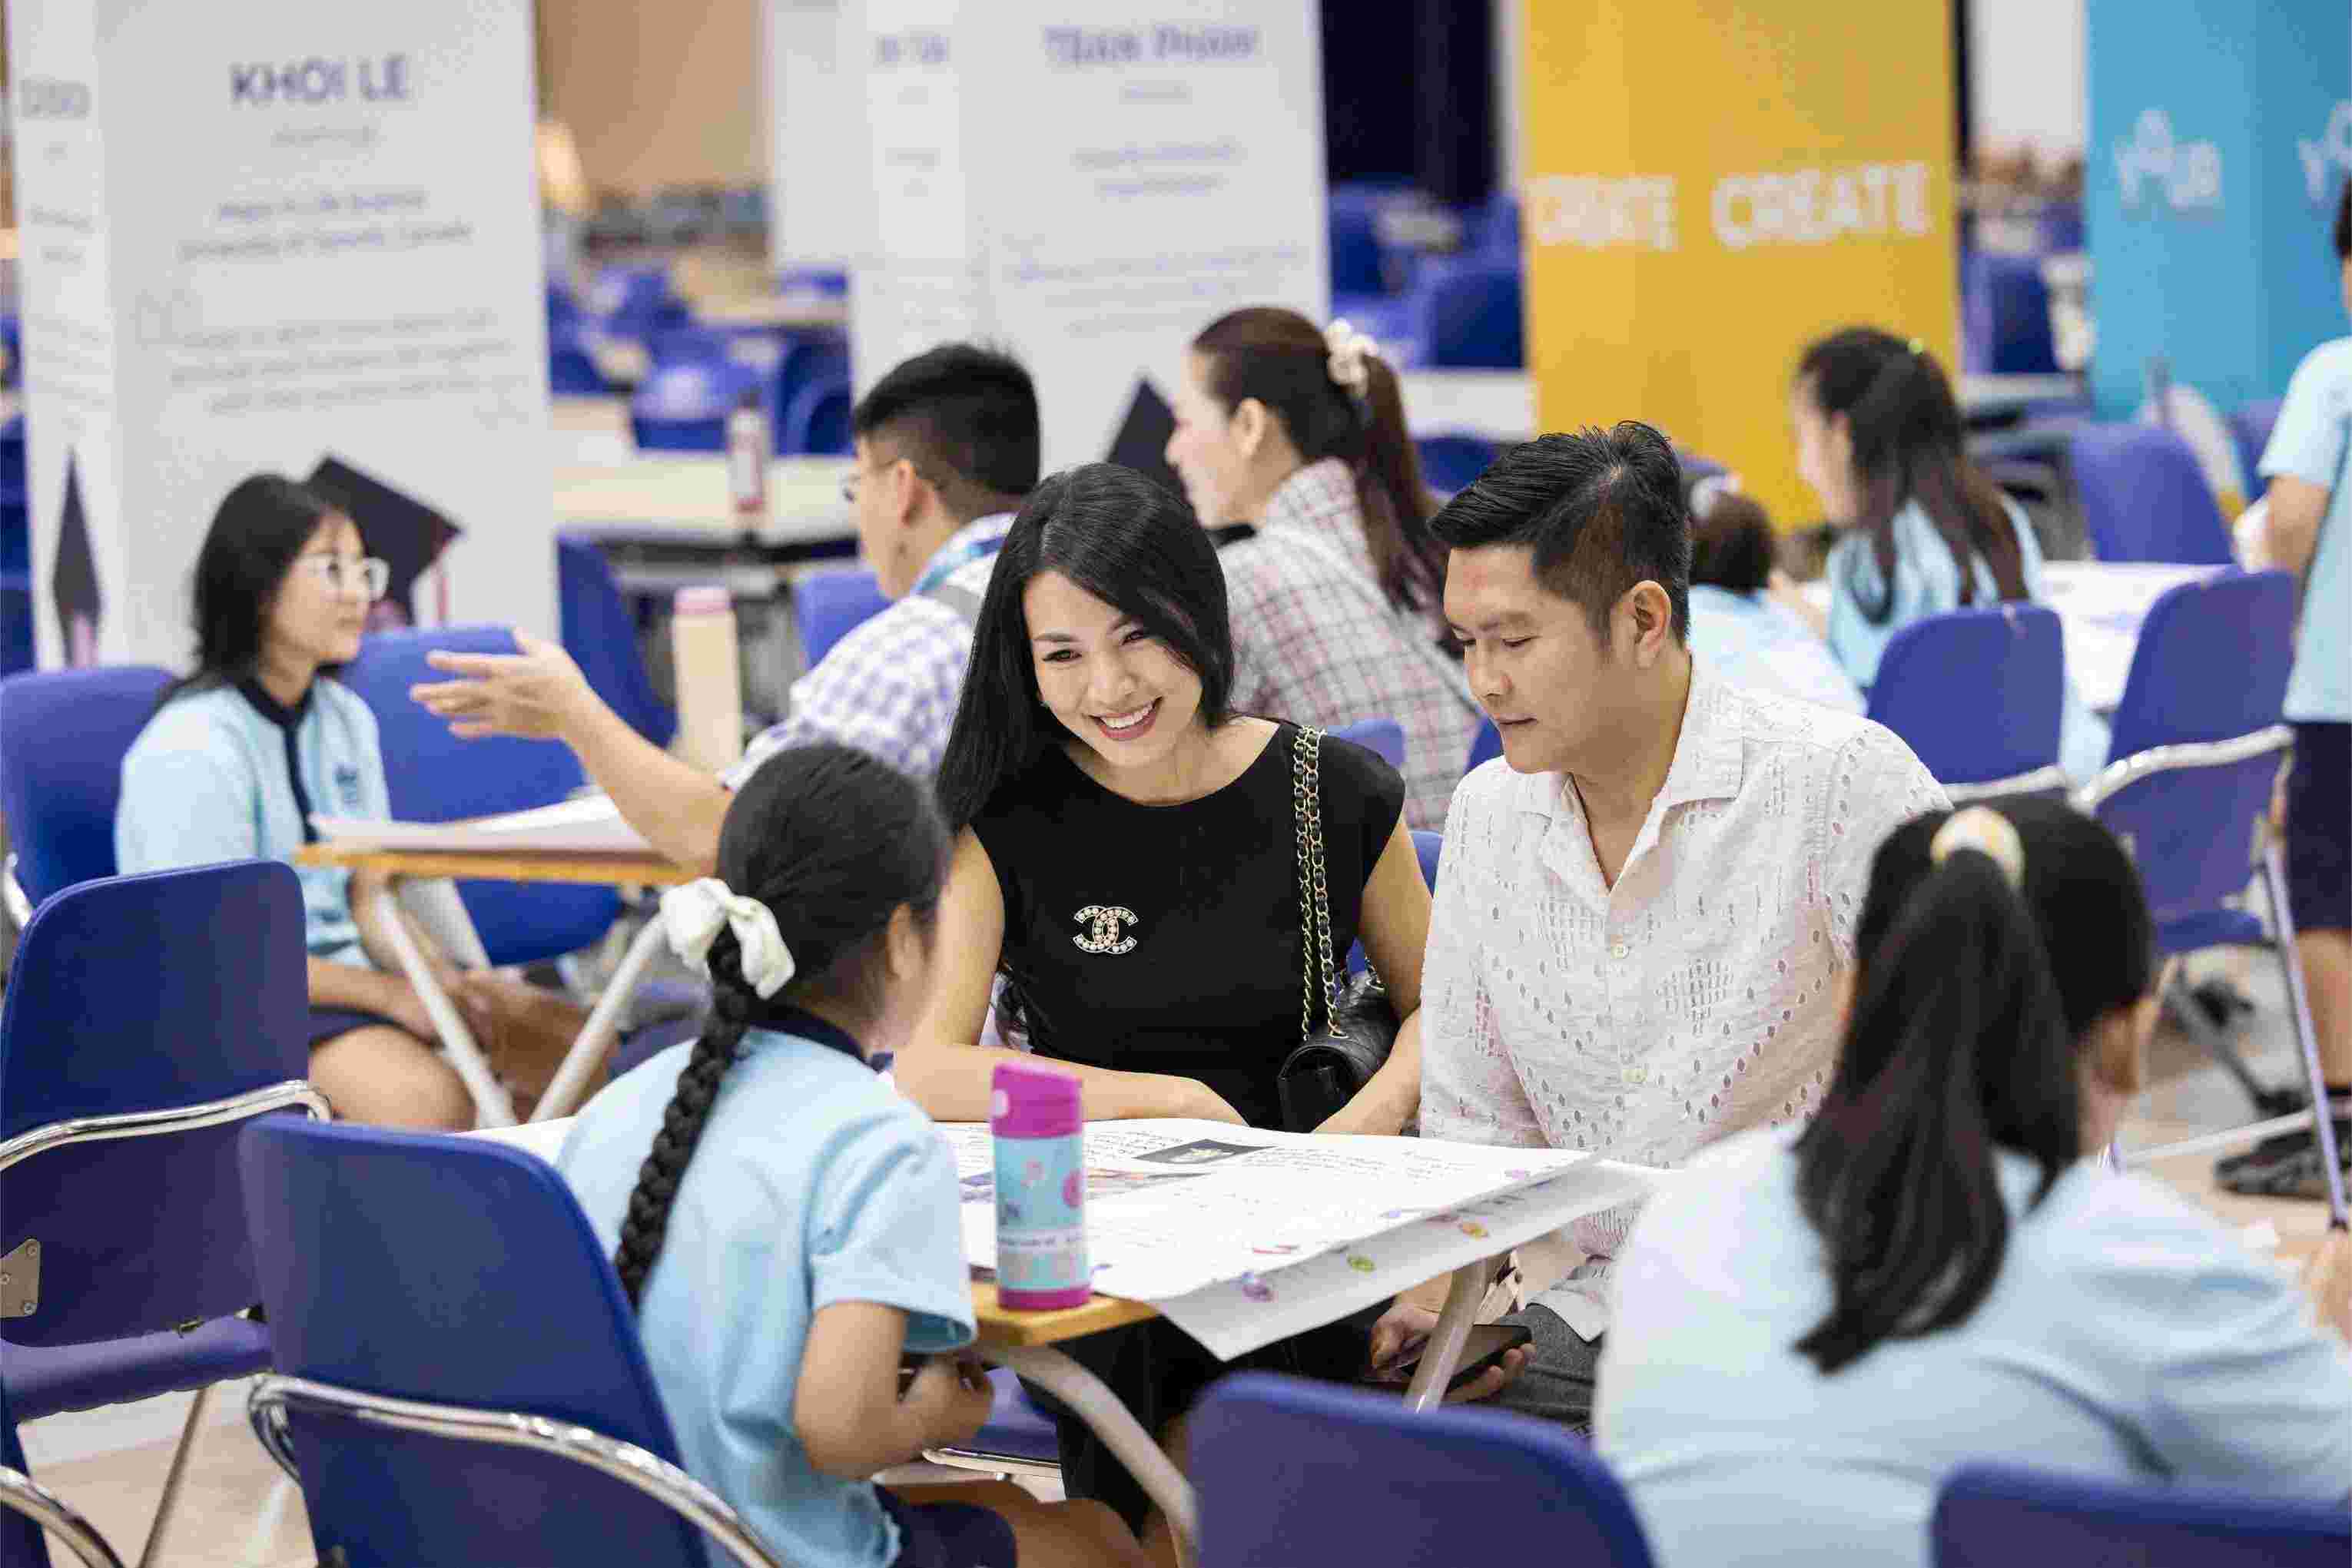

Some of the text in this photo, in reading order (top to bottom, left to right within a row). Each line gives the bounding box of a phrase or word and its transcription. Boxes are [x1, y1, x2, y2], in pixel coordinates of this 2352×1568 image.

[231, 54, 410, 104] KHOI LE
[1711, 161, 1929, 247] CREATE
